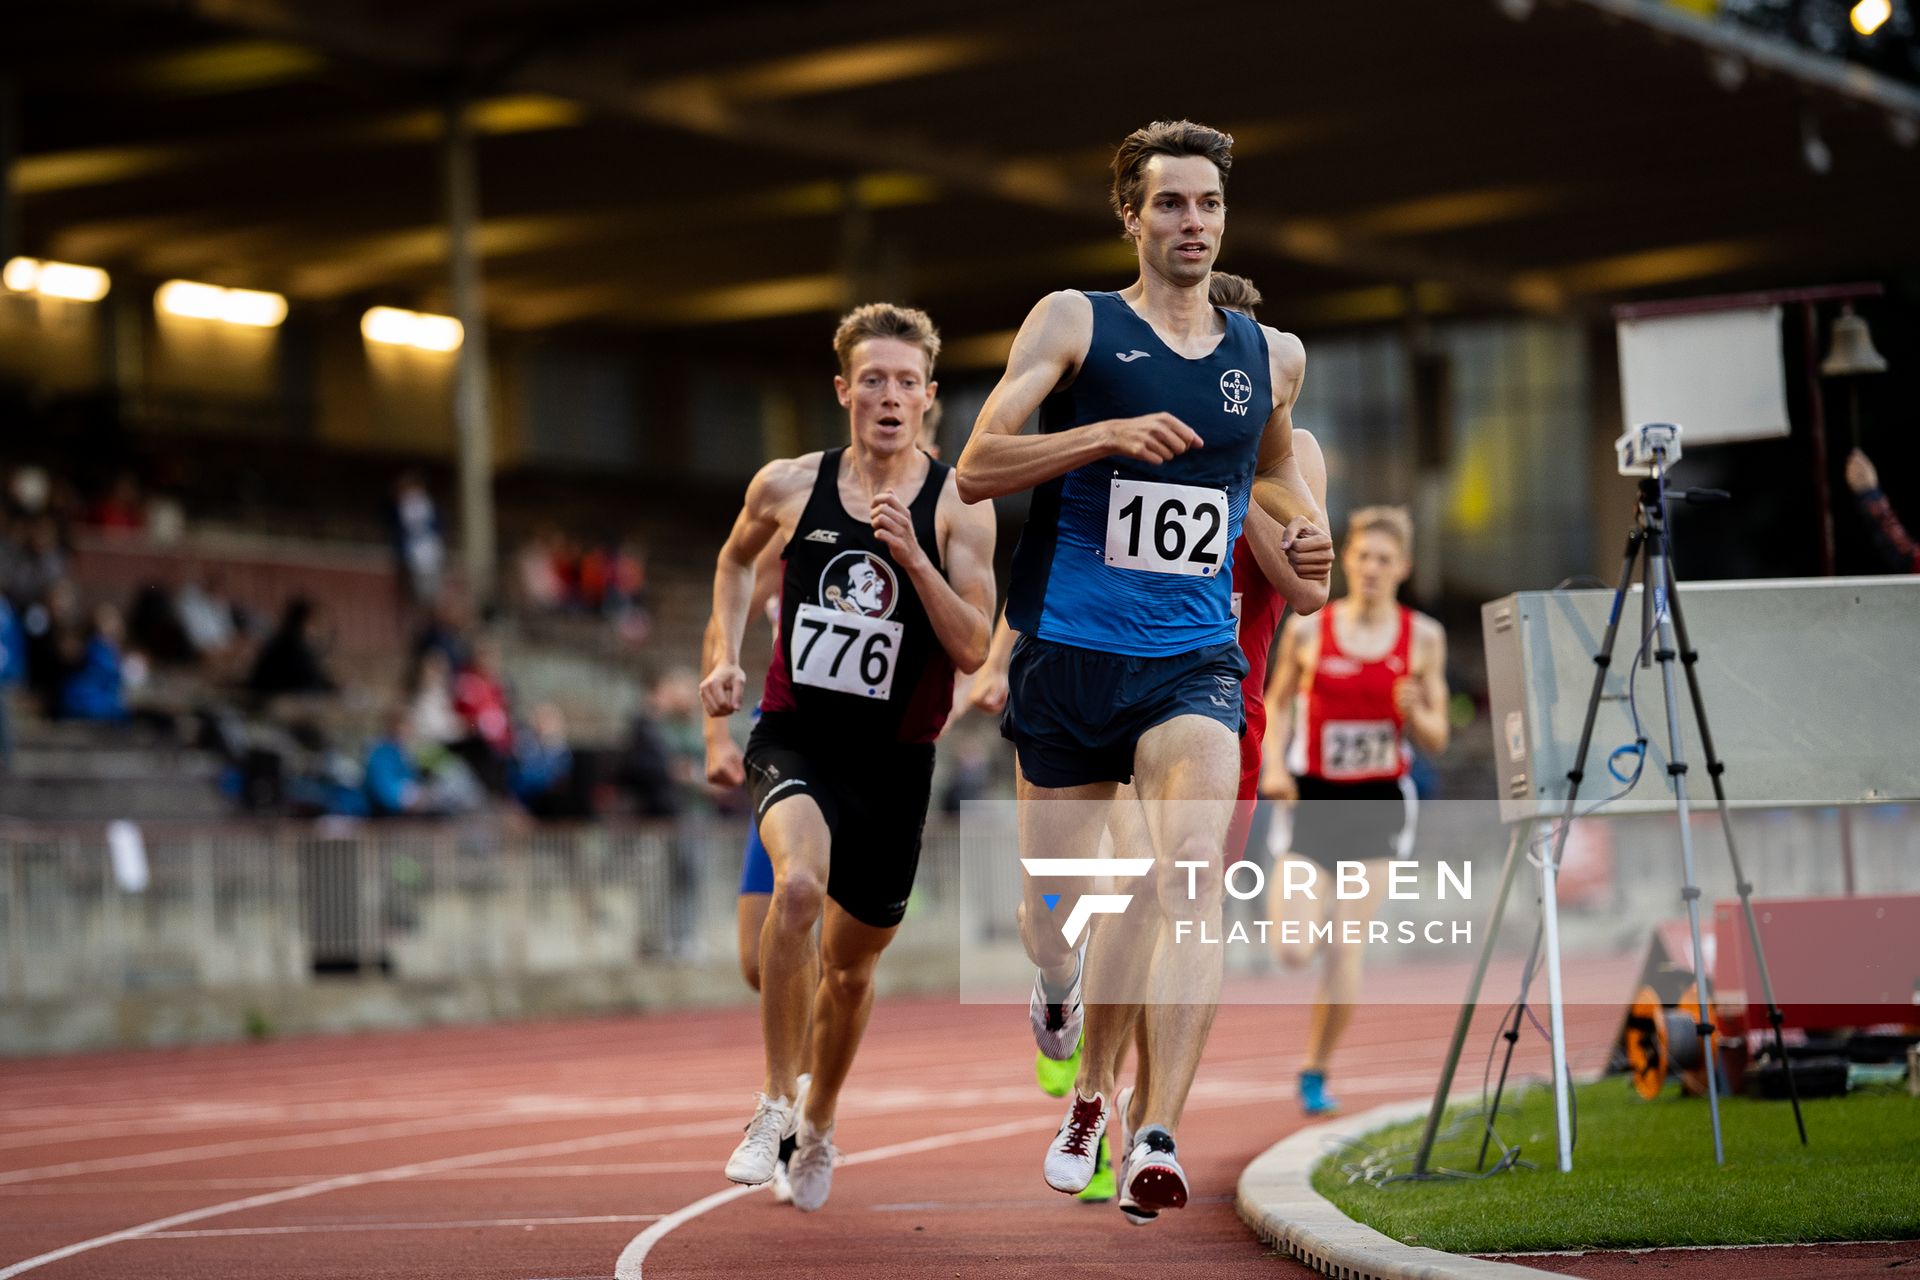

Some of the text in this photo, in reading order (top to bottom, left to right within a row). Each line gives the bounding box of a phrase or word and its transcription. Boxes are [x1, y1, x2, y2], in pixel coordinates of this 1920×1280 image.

[1223, 401, 1248, 416] LAV
[1118, 495, 1221, 565] 162
[796, 618, 892, 686] 776
